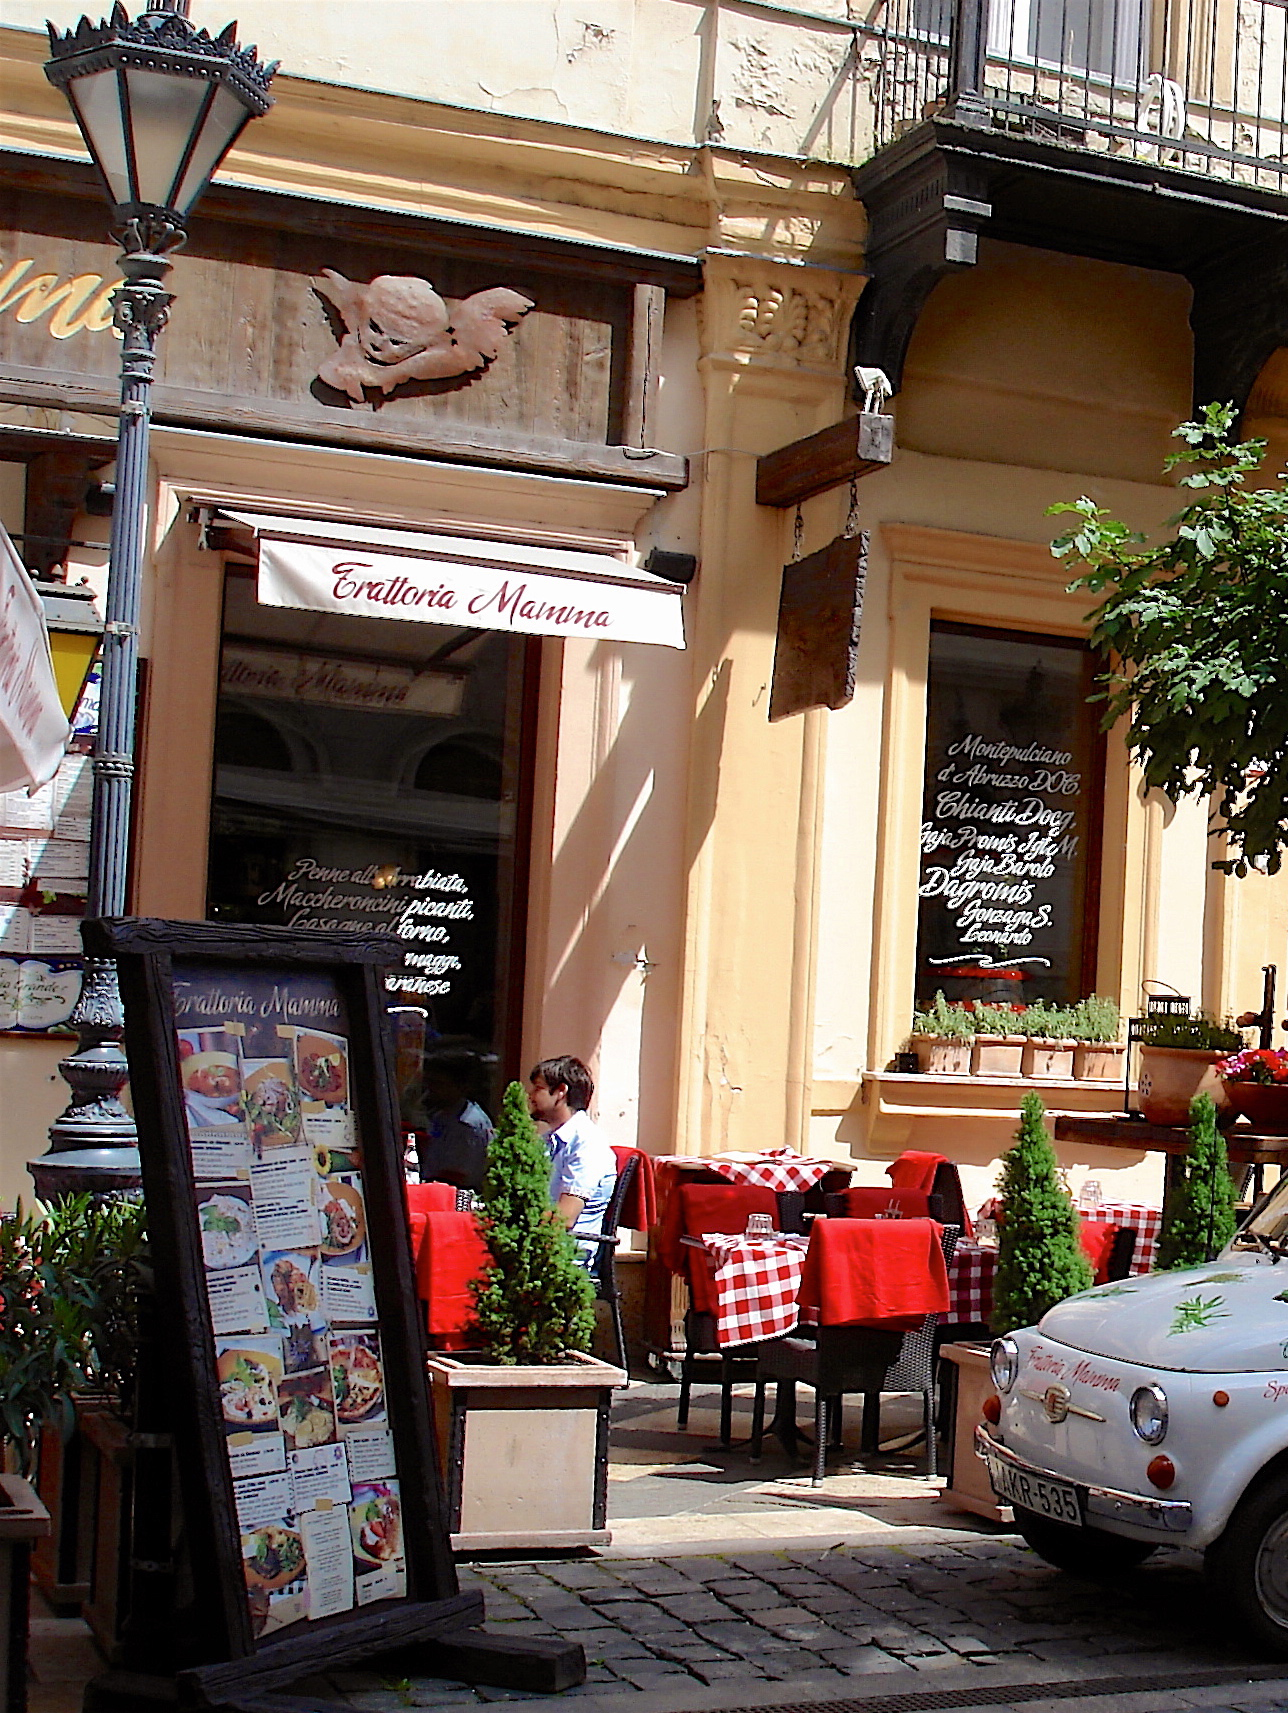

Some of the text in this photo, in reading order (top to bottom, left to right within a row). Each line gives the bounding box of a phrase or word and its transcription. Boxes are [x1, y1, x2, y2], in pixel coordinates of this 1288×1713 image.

[331, 561, 613, 626] Trattoria Mamma
[948, 734, 1073, 767] Montepulciano
[935, 791, 1019, 823] Chianti
[288, 858, 351, 884] Penne
[950, 849, 1055, 880] Gaja Barolo
[257, 881, 408, 914] Maccheroncini
[919, 866, 1036, 909] Dagromis
[959, 922, 1033, 945] Leonardo
[260, 985, 341, 1023] Mamma
